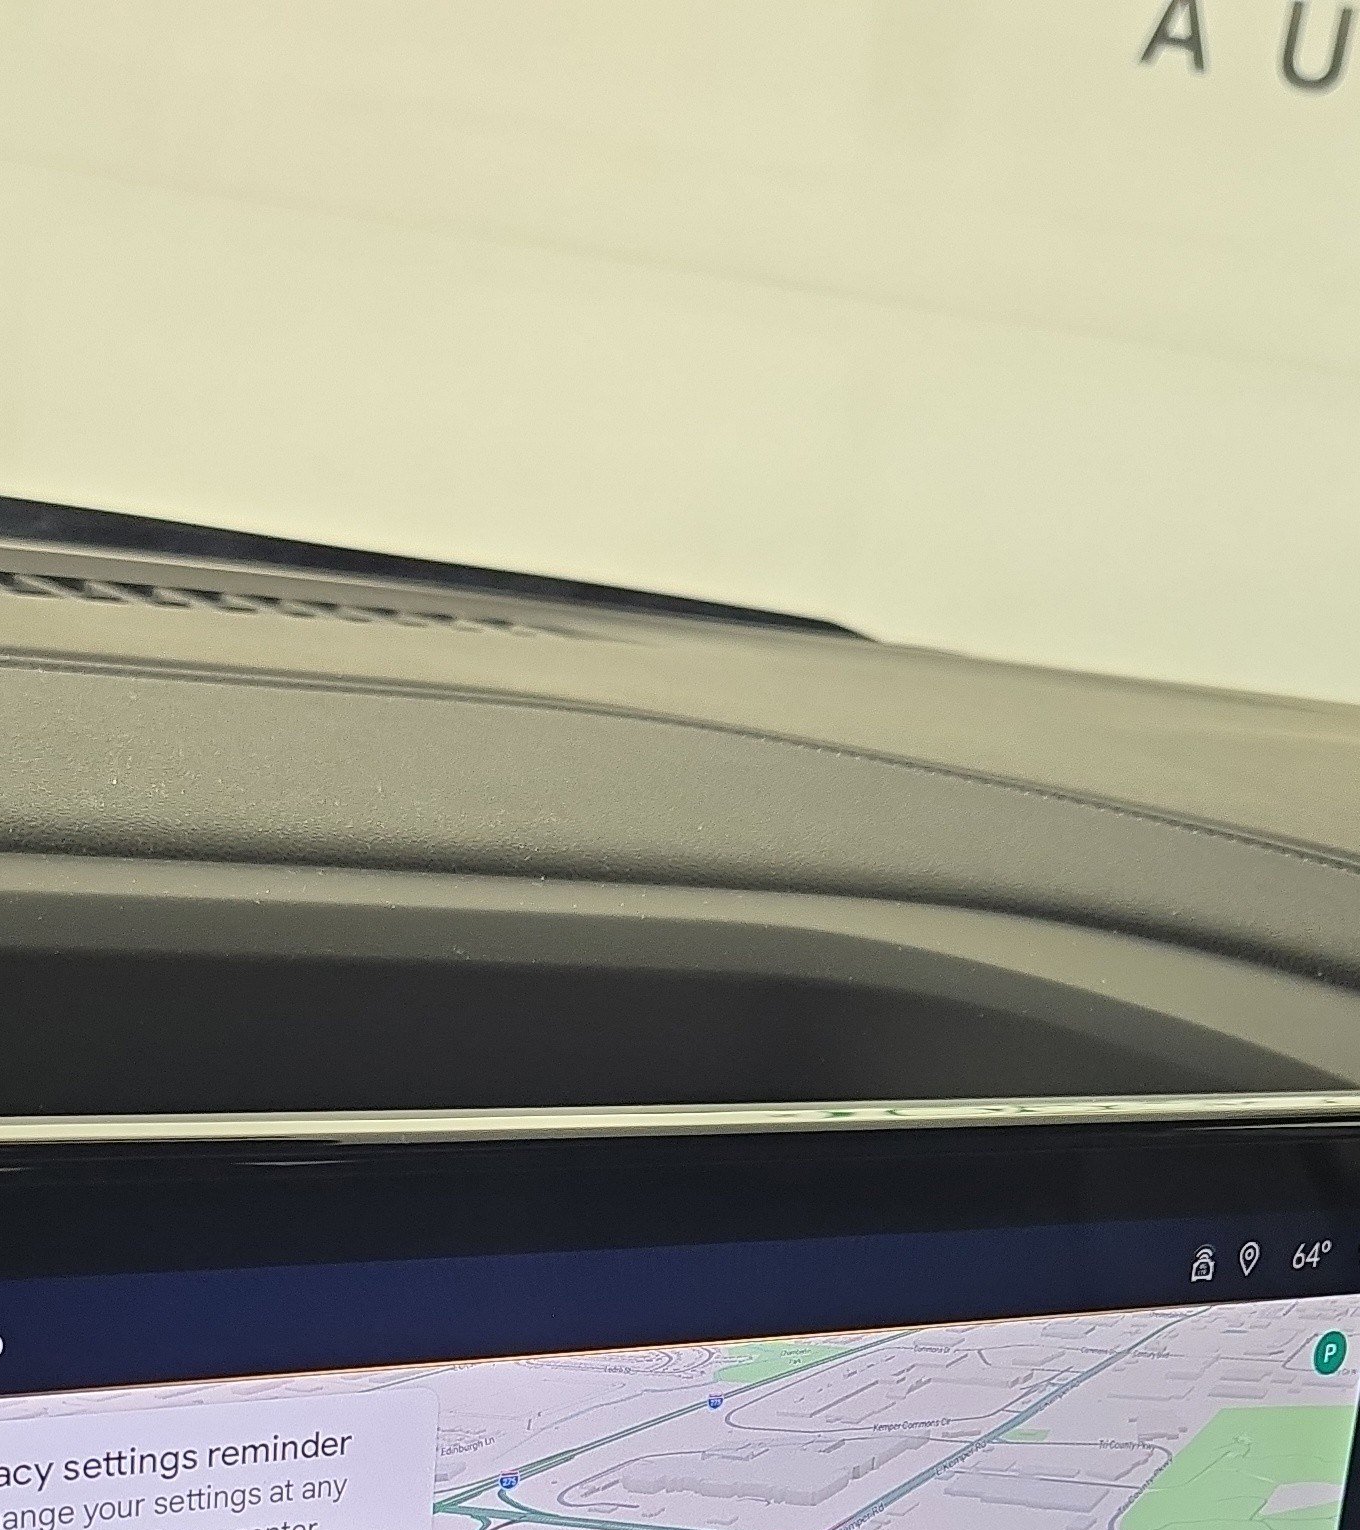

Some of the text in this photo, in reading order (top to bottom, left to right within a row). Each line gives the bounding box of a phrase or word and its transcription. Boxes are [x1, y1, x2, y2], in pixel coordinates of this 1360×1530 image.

[63, 1446, 197, 1481] settings
[207, 1431, 352, 1468] reminder
[440, 1436, 495, 1456] Edinburgh Ln
[83, 1496, 145, 1529] your
[153, 1483, 261, 1513] settings
[269, 1481, 294, 1502] at
[301, 1476, 348, 1503] any
